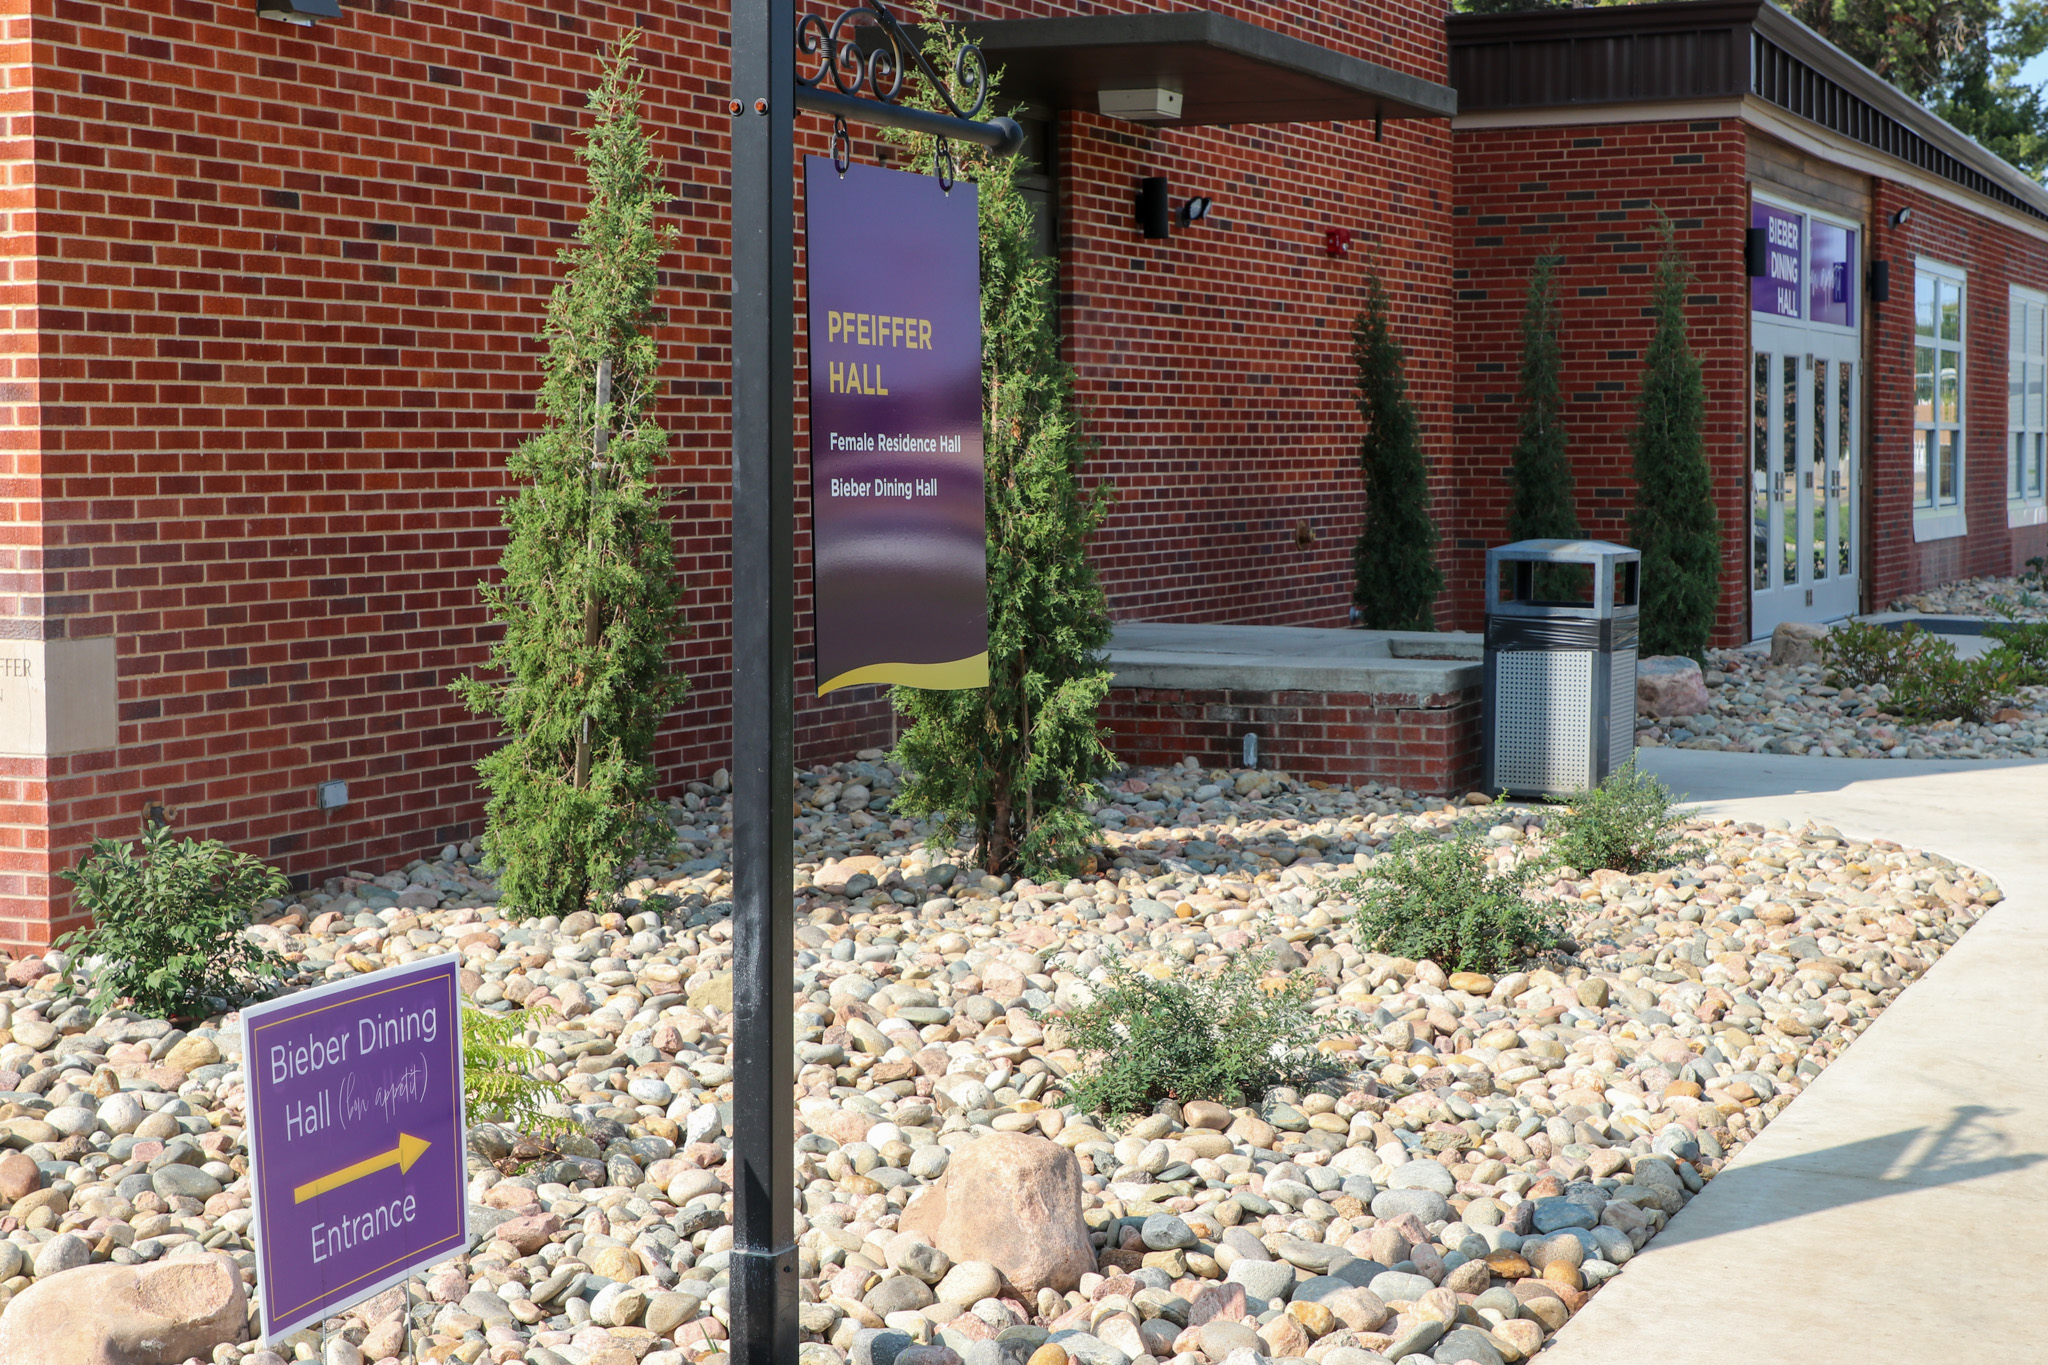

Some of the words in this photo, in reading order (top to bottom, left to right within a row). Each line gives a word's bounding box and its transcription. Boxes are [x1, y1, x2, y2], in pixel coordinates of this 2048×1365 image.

[1768, 216, 1799, 250] BIEBER
[1771, 251, 1798, 284] DINING
[1777, 286, 1798, 317] HALL
[828, 310, 933, 350] PFEIFFER
[829, 361, 889, 396] HALL
[830, 432, 875, 451] Female
[877, 433, 937, 452] Residence
[939, 435, 961, 453] Hall
[831, 478, 871, 497] Bieber
[874, 478, 913, 500] Dining
[915, 478, 938, 496] Hall
[270, 1031, 350, 1085] Bieber
[358, 1007, 437, 1056] Dining
[285, 1089, 332, 1142] Hall
[310, 1194, 417, 1265] Entrance
